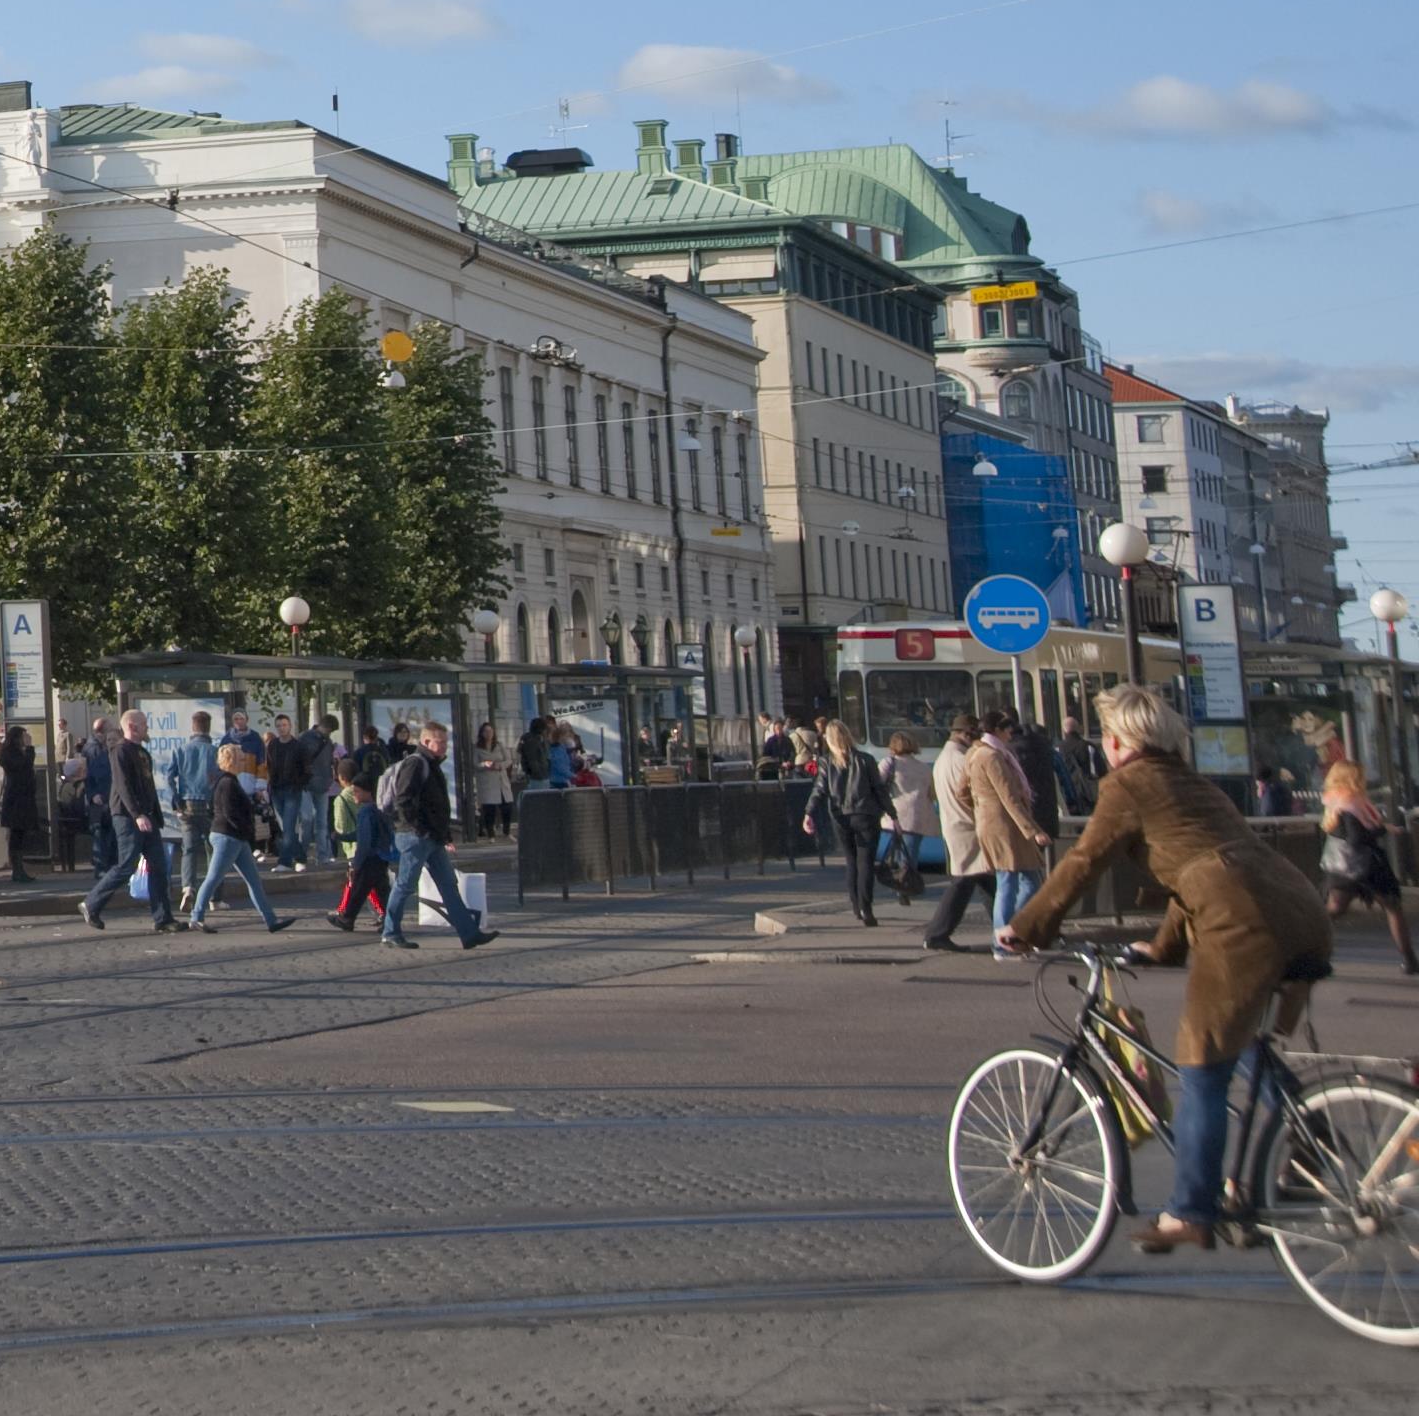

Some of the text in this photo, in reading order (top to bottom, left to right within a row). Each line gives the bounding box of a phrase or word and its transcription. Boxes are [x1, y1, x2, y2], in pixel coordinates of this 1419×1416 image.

[1195, 598, 1216, 621] B
[13, 614, 32, 635] A
[906, 631, 923, 657] 5
[684, 651, 697, 664] A
[157, 711, 177, 729] vill
